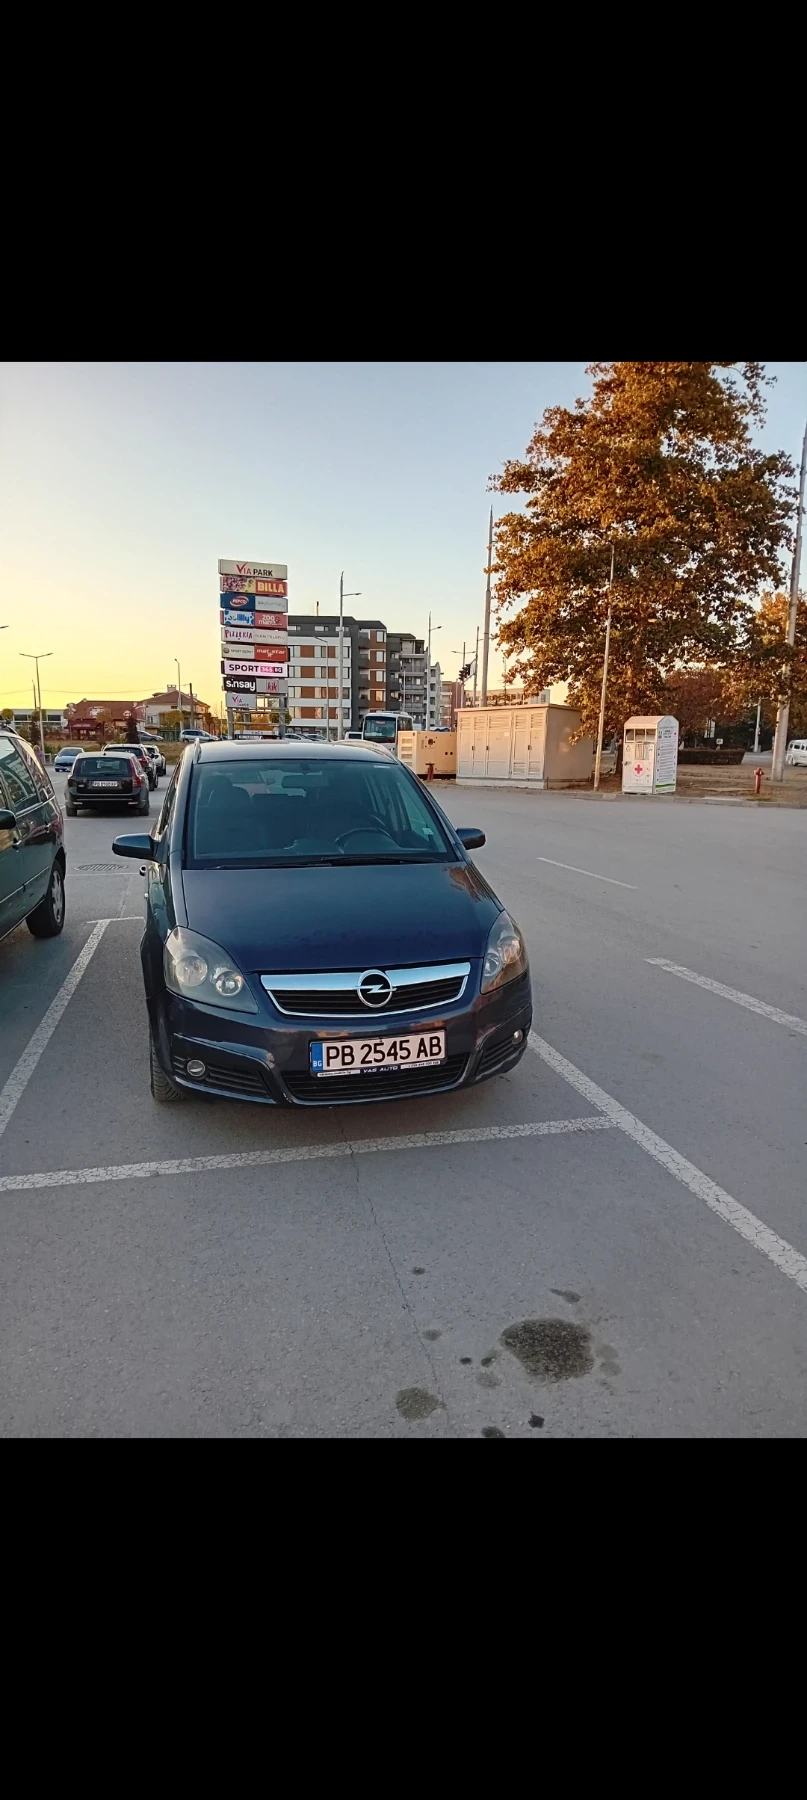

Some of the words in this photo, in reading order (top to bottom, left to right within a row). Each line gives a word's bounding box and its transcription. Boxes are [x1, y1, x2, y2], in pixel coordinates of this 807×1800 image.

[236, 562, 252, 575] VIA
[253, 568, 273, 577] PARK
[257, 581, 285, 593] BILLA
[224, 629, 253, 639] PIZZERIA
[229, 663, 259, 672] SPORT
[226, 679, 256, 691] sinsay
[232, 695, 244, 704] VIA
[326, 1045, 355, 1067] PB
[360, 1039, 411, 1065] 2545
[416, 1036, 442, 1058] AB
